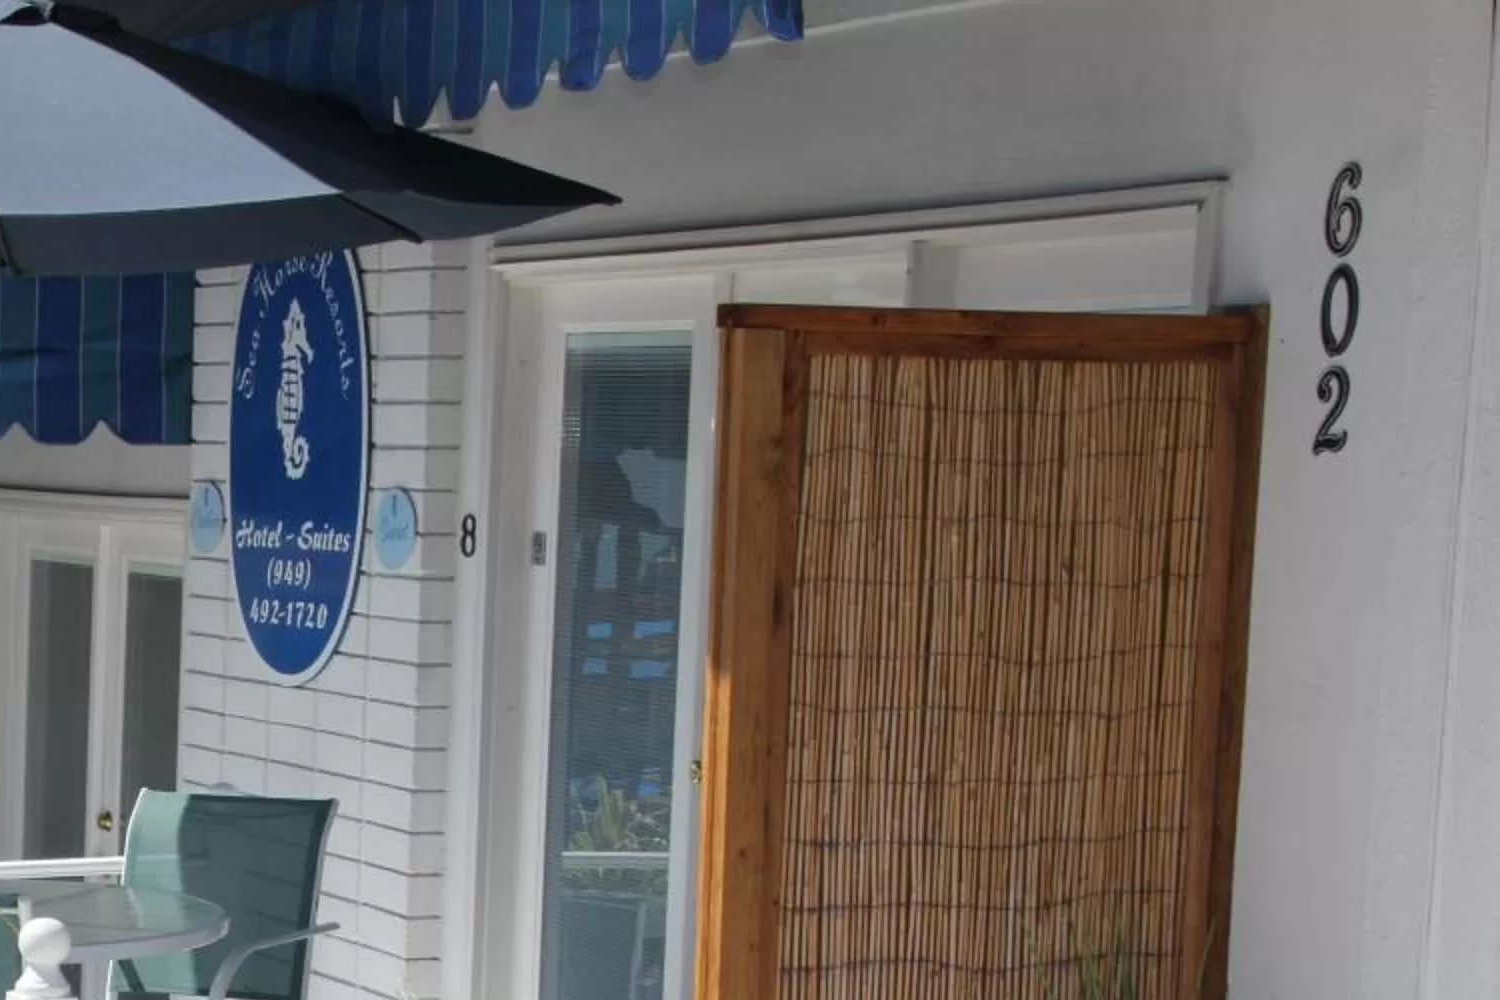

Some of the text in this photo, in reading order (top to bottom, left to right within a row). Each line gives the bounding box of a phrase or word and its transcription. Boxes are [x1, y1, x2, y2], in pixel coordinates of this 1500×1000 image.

[252, 256, 310, 312] Horse
[1312, 161, 1363, 456] 602
[235, 518, 284, 549] Hotel
[296, 520, 351, 553] Suites
[460, 513, 477, 558] 8
[266, 556, 312, 589] (949)
[250, 598, 329, 630] 492-1720
